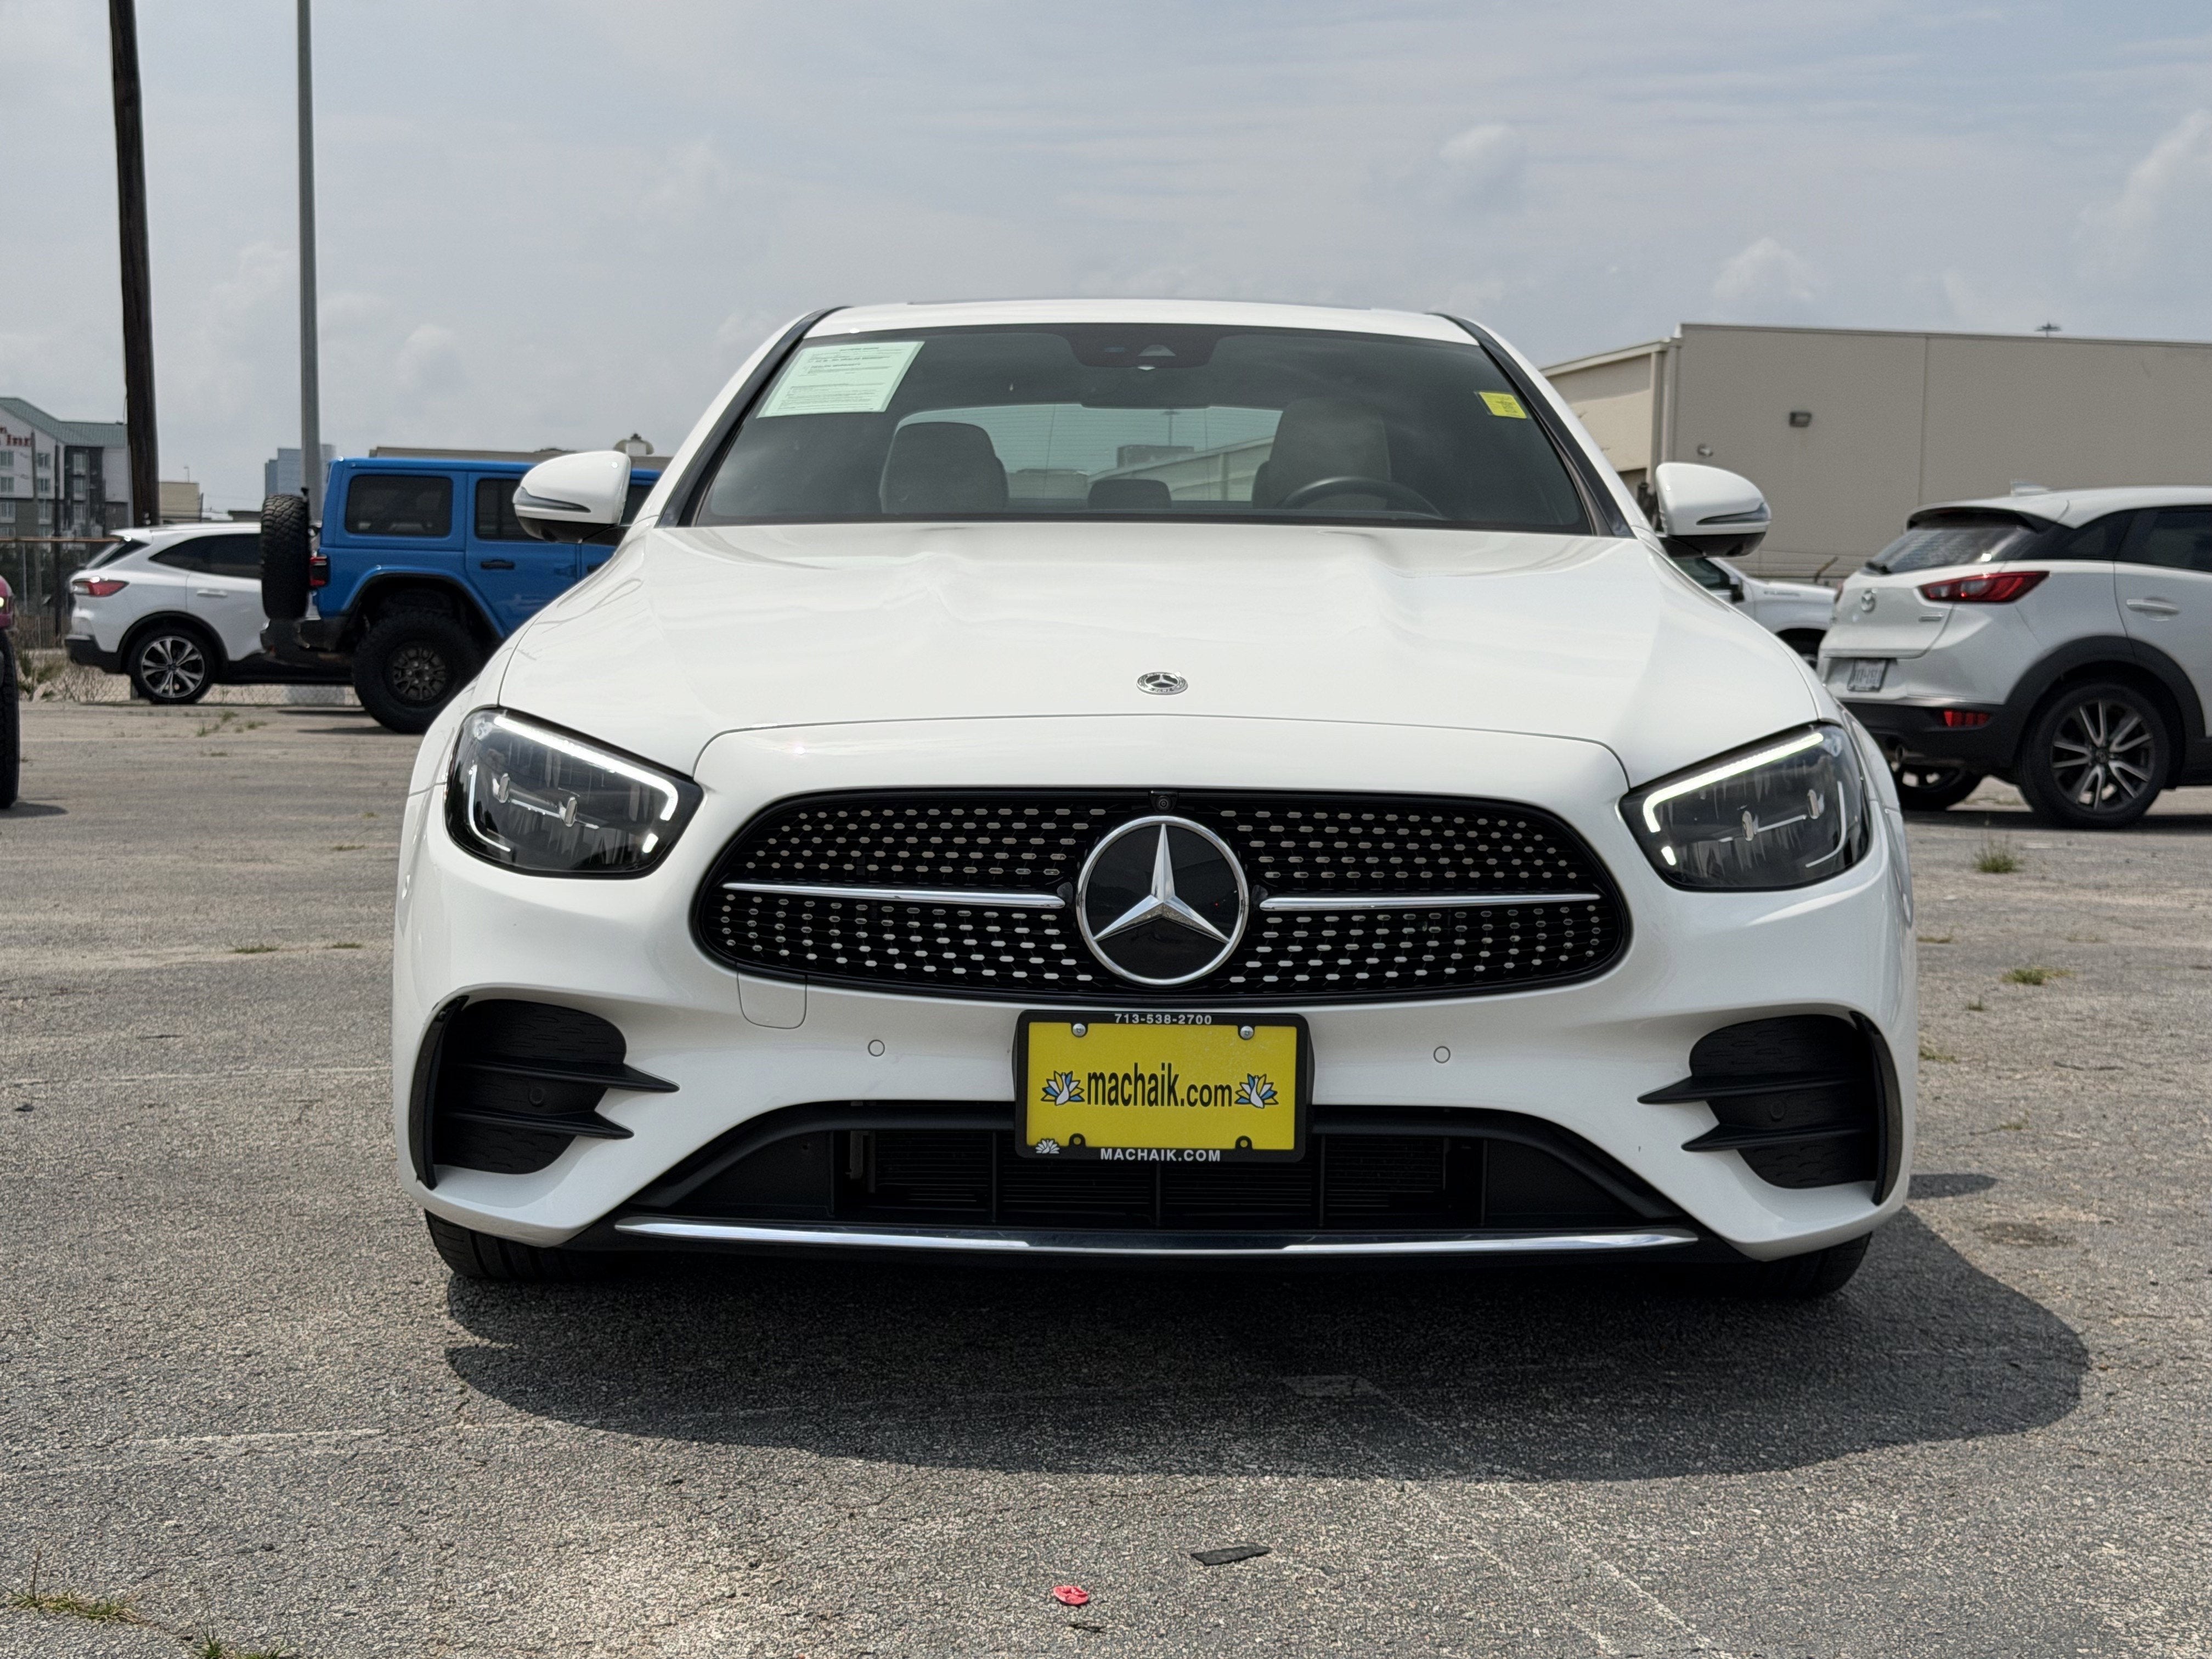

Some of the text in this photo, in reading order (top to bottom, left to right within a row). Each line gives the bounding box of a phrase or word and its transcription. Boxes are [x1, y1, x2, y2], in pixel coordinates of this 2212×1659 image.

[1114, 1013, 1212, 1025] 713-538-2700
[1087, 1062, 1232, 1107] machaik.com
[1100, 1148, 1221, 1161] MACHAIK.COM
